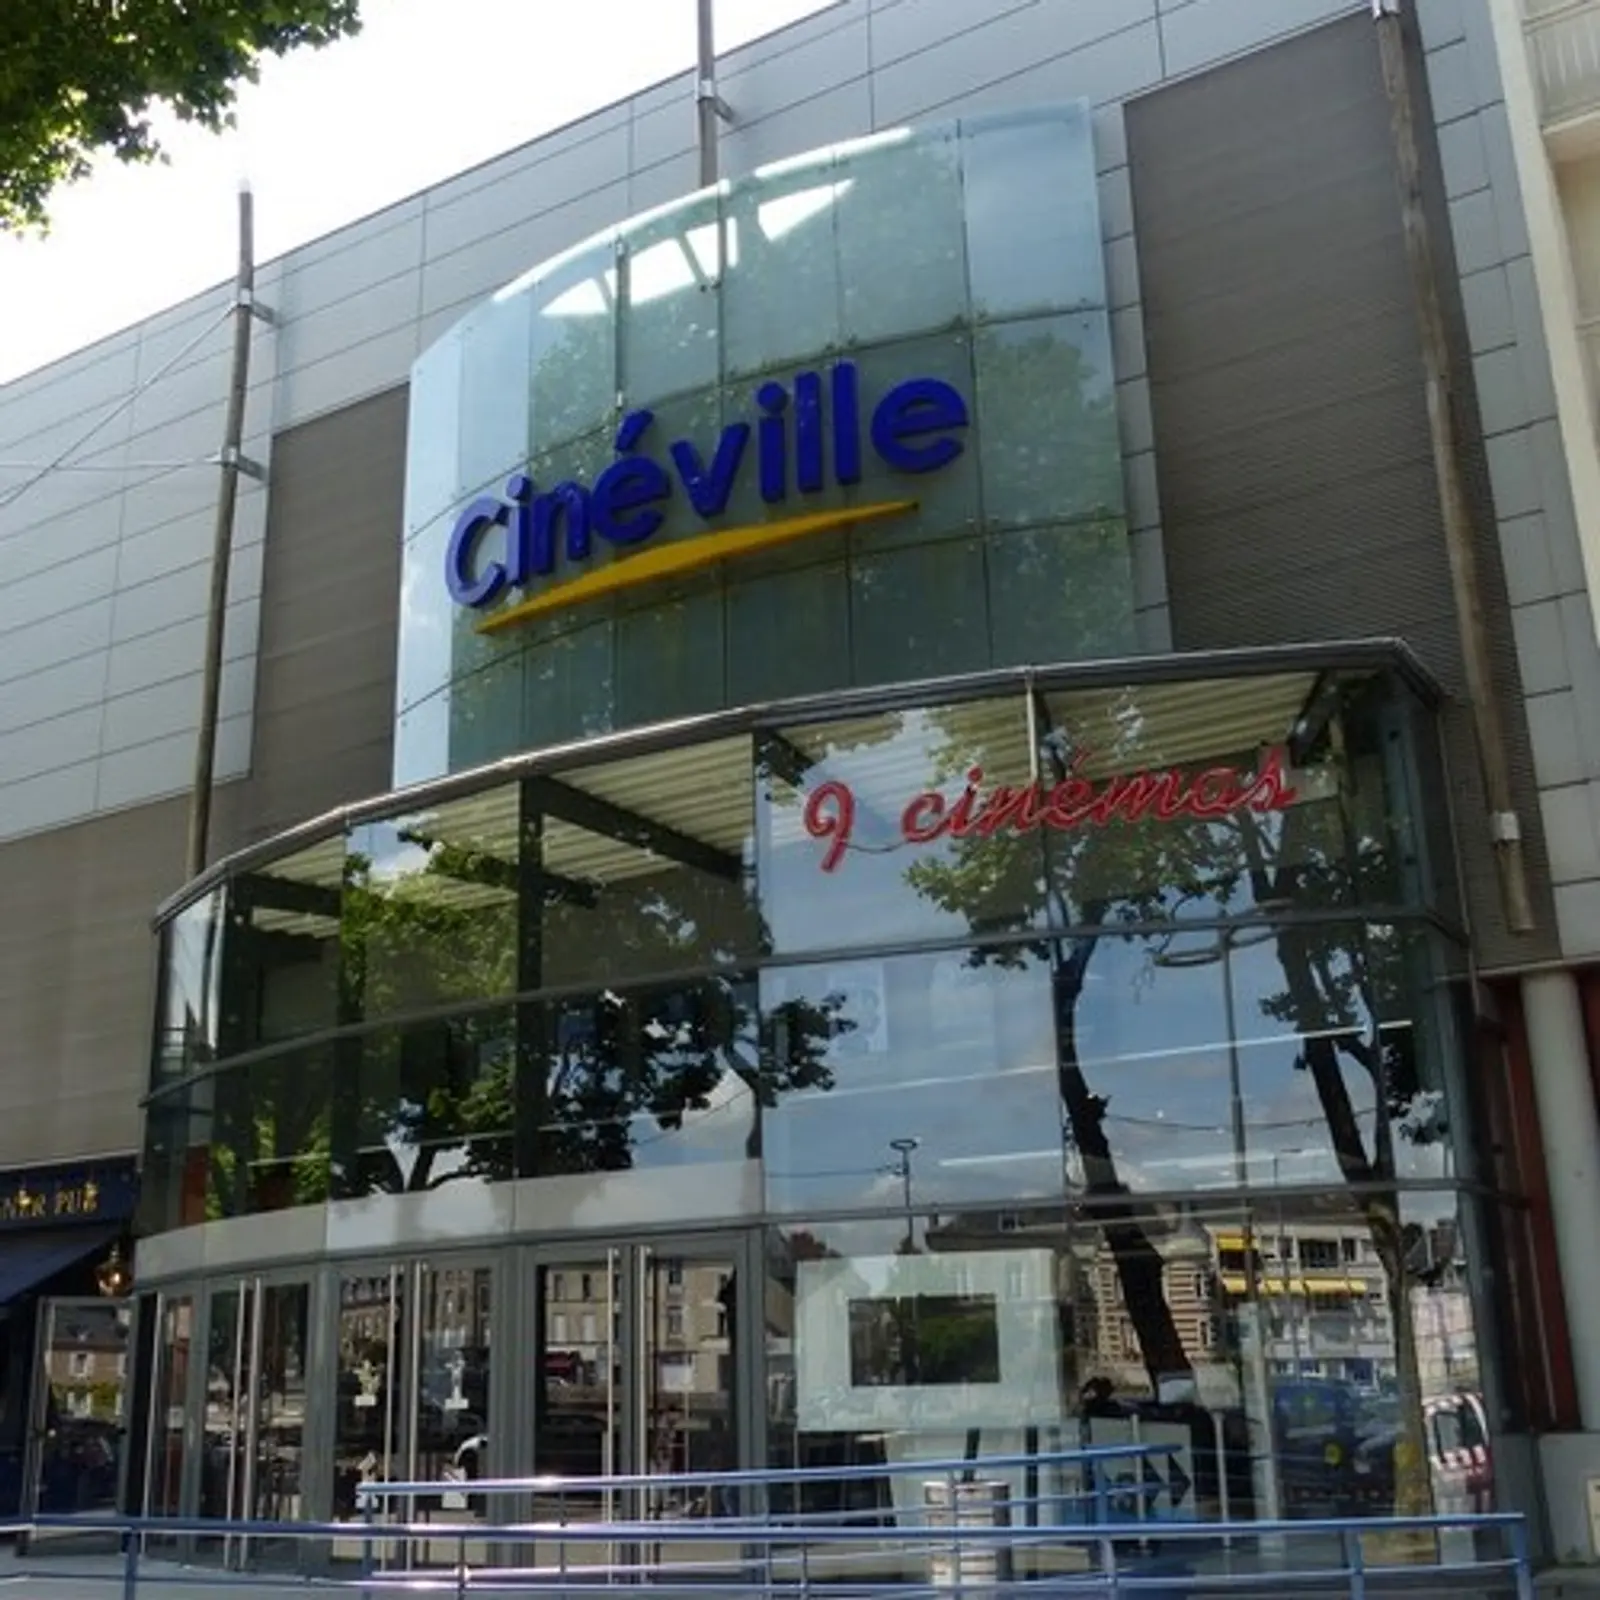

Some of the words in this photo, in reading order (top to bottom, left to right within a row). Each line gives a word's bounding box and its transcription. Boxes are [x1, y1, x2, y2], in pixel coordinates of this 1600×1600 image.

[444, 359, 969, 608] Cinéville
[803, 780, 856, 872] 9
[902, 745, 1300, 843] cinémas
